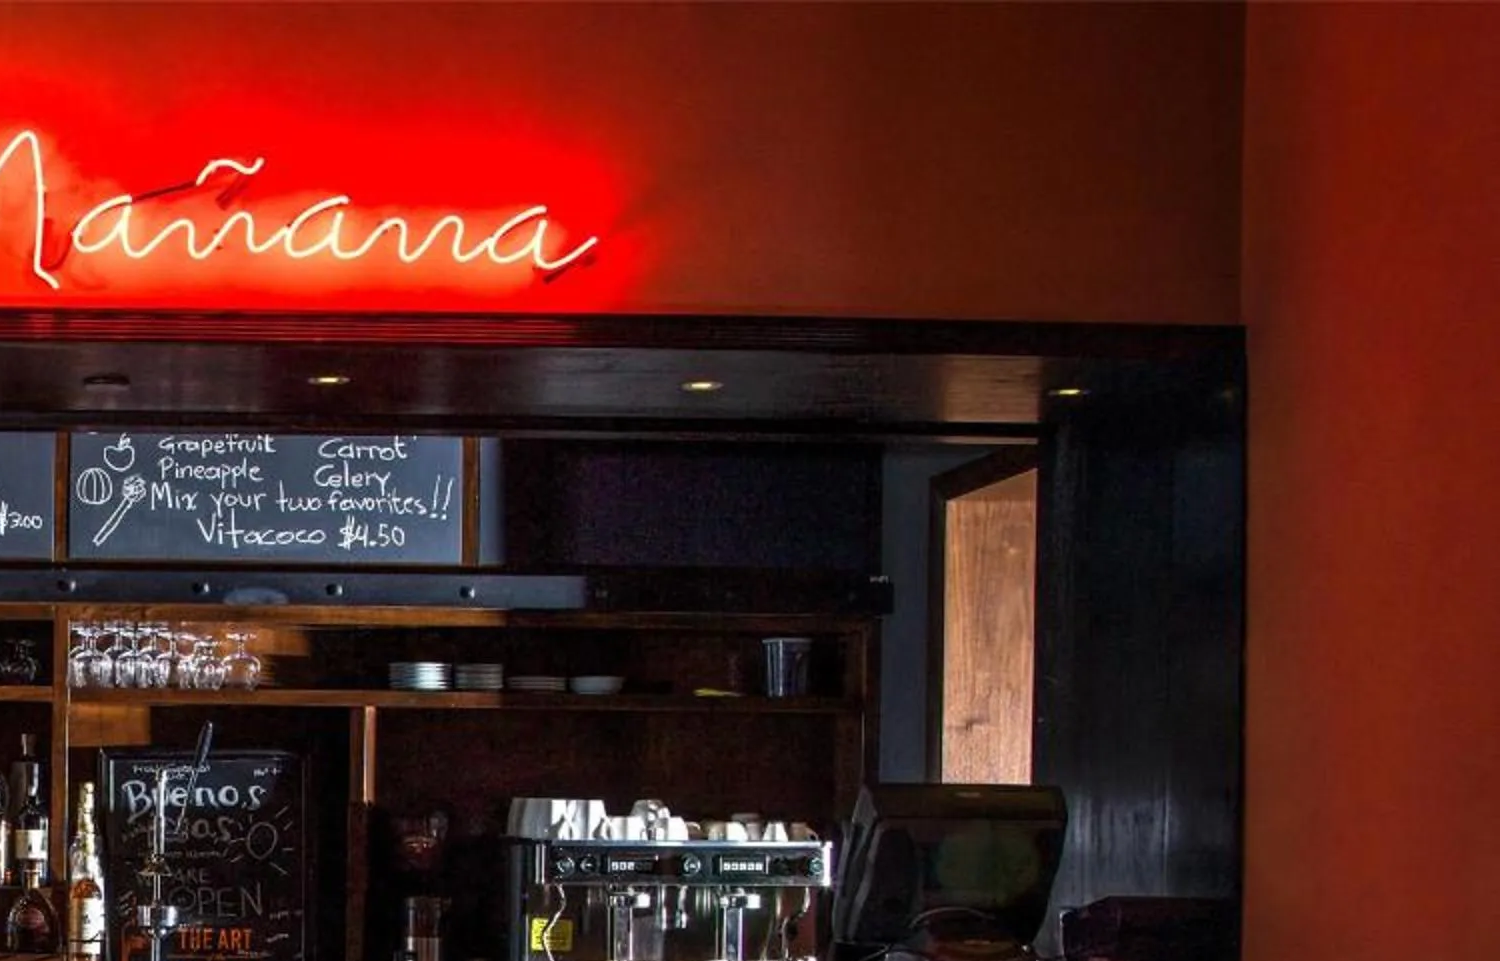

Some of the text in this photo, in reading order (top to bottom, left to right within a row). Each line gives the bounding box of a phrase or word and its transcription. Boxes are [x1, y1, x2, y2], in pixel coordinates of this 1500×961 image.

[158, 433, 277, 459] Grapefruit
[318, 435, 408, 461] Carrot
[157, 455, 264, 489] Pineapple
[313, 460, 391, 496] Celery
[150, 481, 199, 511] Mix
[209, 491, 267, 519] your
[275, 480, 323, 513] two
[197, 507, 406, 550] Vitacoco $4.50
[168, 881, 264, 919] OPEN
[177, 927, 214, 951] THE
[217, 927, 253, 951] ART
